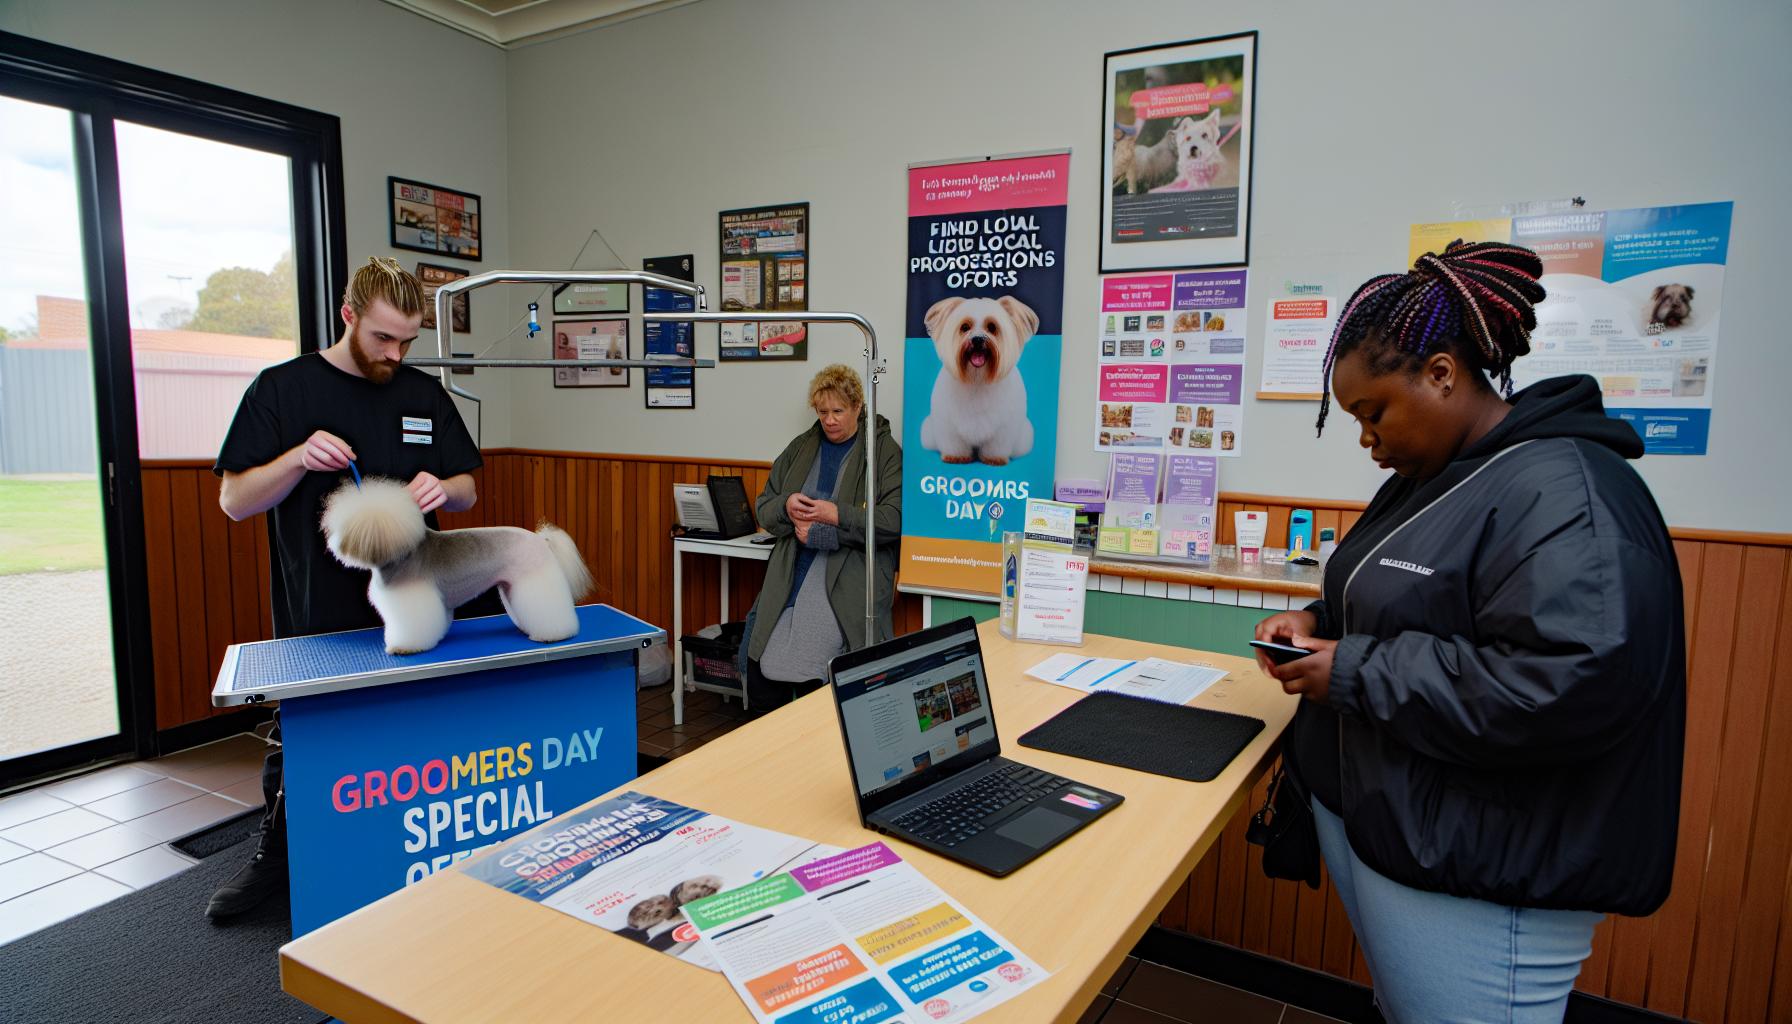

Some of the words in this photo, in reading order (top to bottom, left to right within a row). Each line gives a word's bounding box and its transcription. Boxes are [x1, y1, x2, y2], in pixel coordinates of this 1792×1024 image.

[979, 233, 1042, 251] LOCAL
[331, 742, 534, 813] GROOMERS
[541, 727, 604, 771] DAY
[403, 780, 553, 854] SPECIAL
